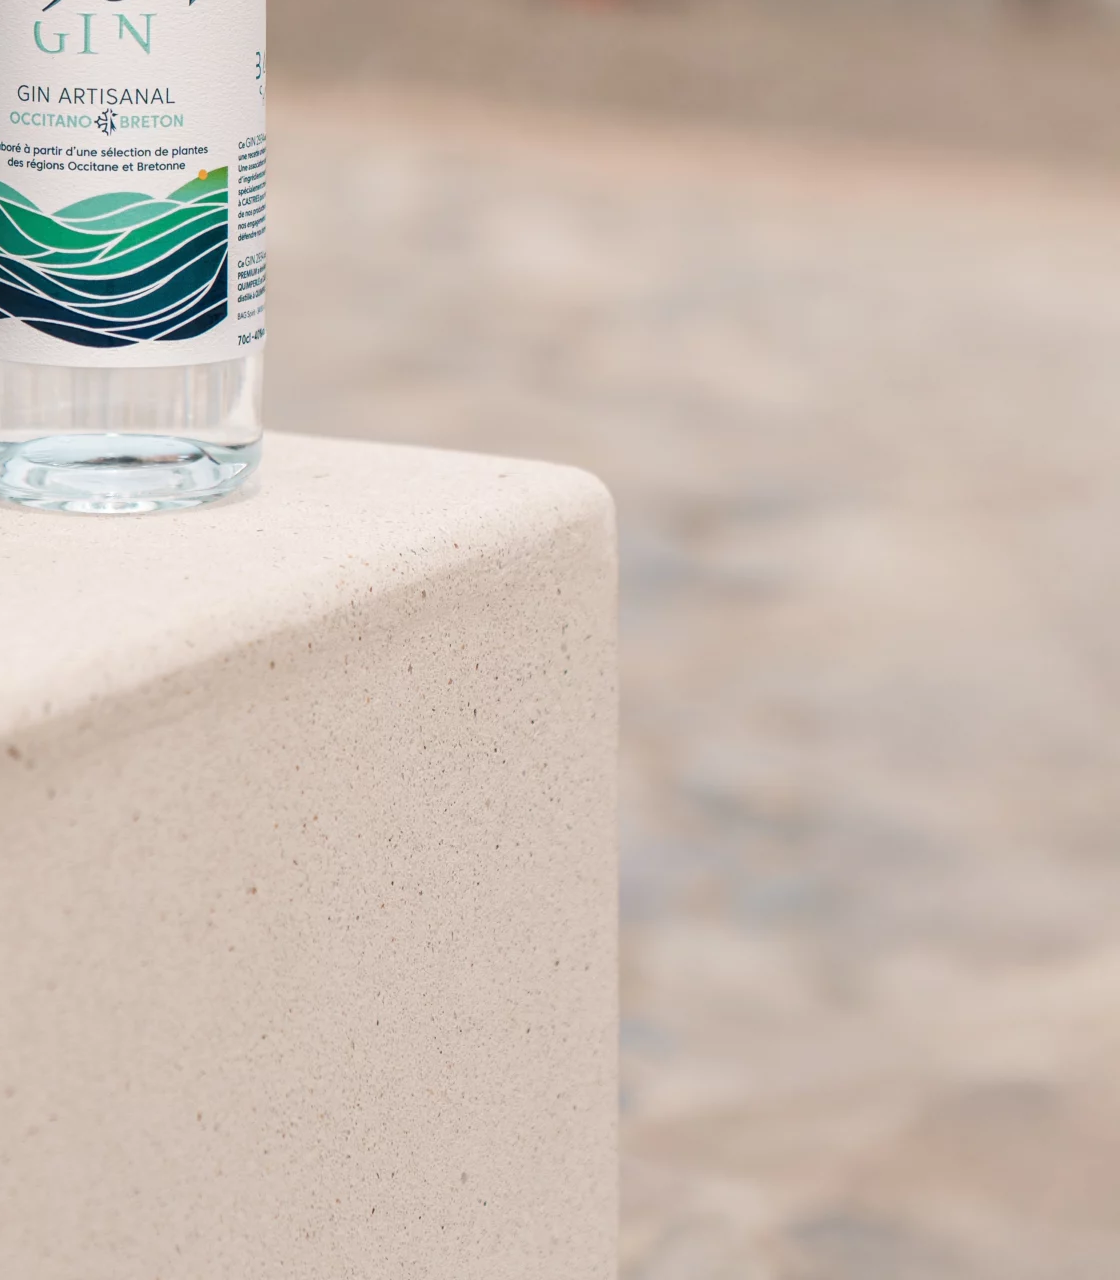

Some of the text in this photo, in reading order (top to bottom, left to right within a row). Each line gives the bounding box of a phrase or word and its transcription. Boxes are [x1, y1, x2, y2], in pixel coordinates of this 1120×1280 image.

[33, 12, 158, 55] GIN
[17, 84, 176, 105] GIN ARTISANAL
[9, 111, 184, 129] OCCITANO BRETON
[23, 143, 31, 153] à
[33, 146, 63, 160] partir
[65, 146, 98, 157] d'une
[100, 146, 152, 158] sélection
[154, 146, 169, 157] de
[171, 144, 208, 158] plantes
[7, 157, 186, 172] des régions Occitane et Bretonne
